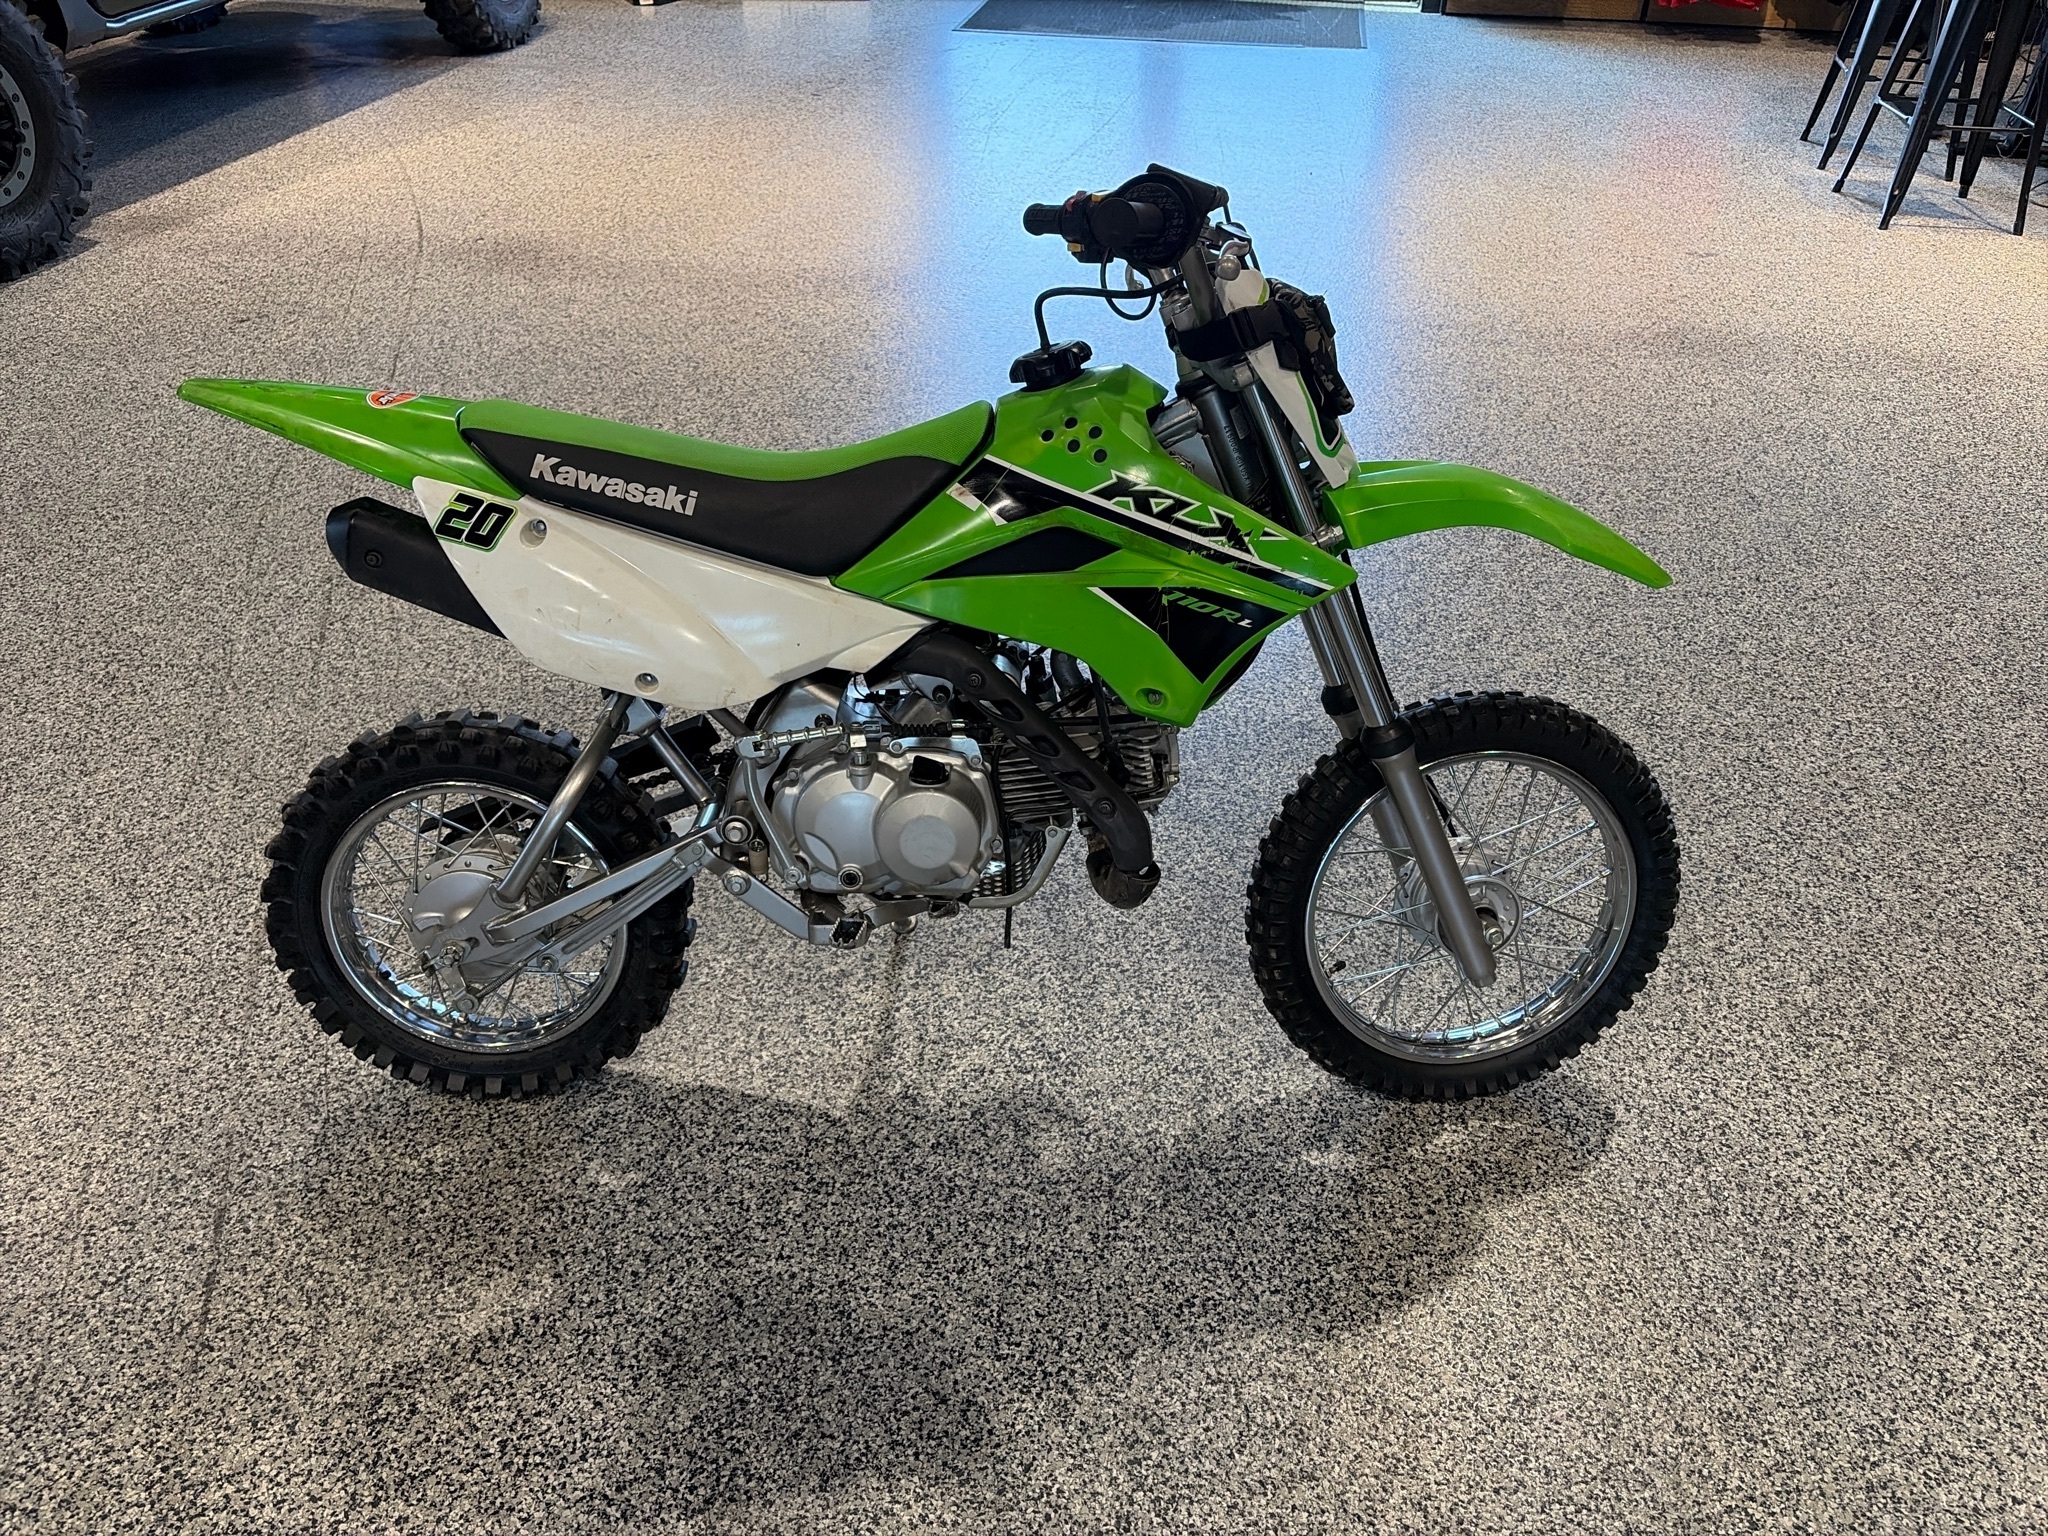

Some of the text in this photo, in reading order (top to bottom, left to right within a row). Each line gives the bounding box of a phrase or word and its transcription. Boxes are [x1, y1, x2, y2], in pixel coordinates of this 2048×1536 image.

[529, 453, 698, 517] Kawasaki
[1084, 469, 1289, 561] KLX
[434, 491, 516, 549] 20
